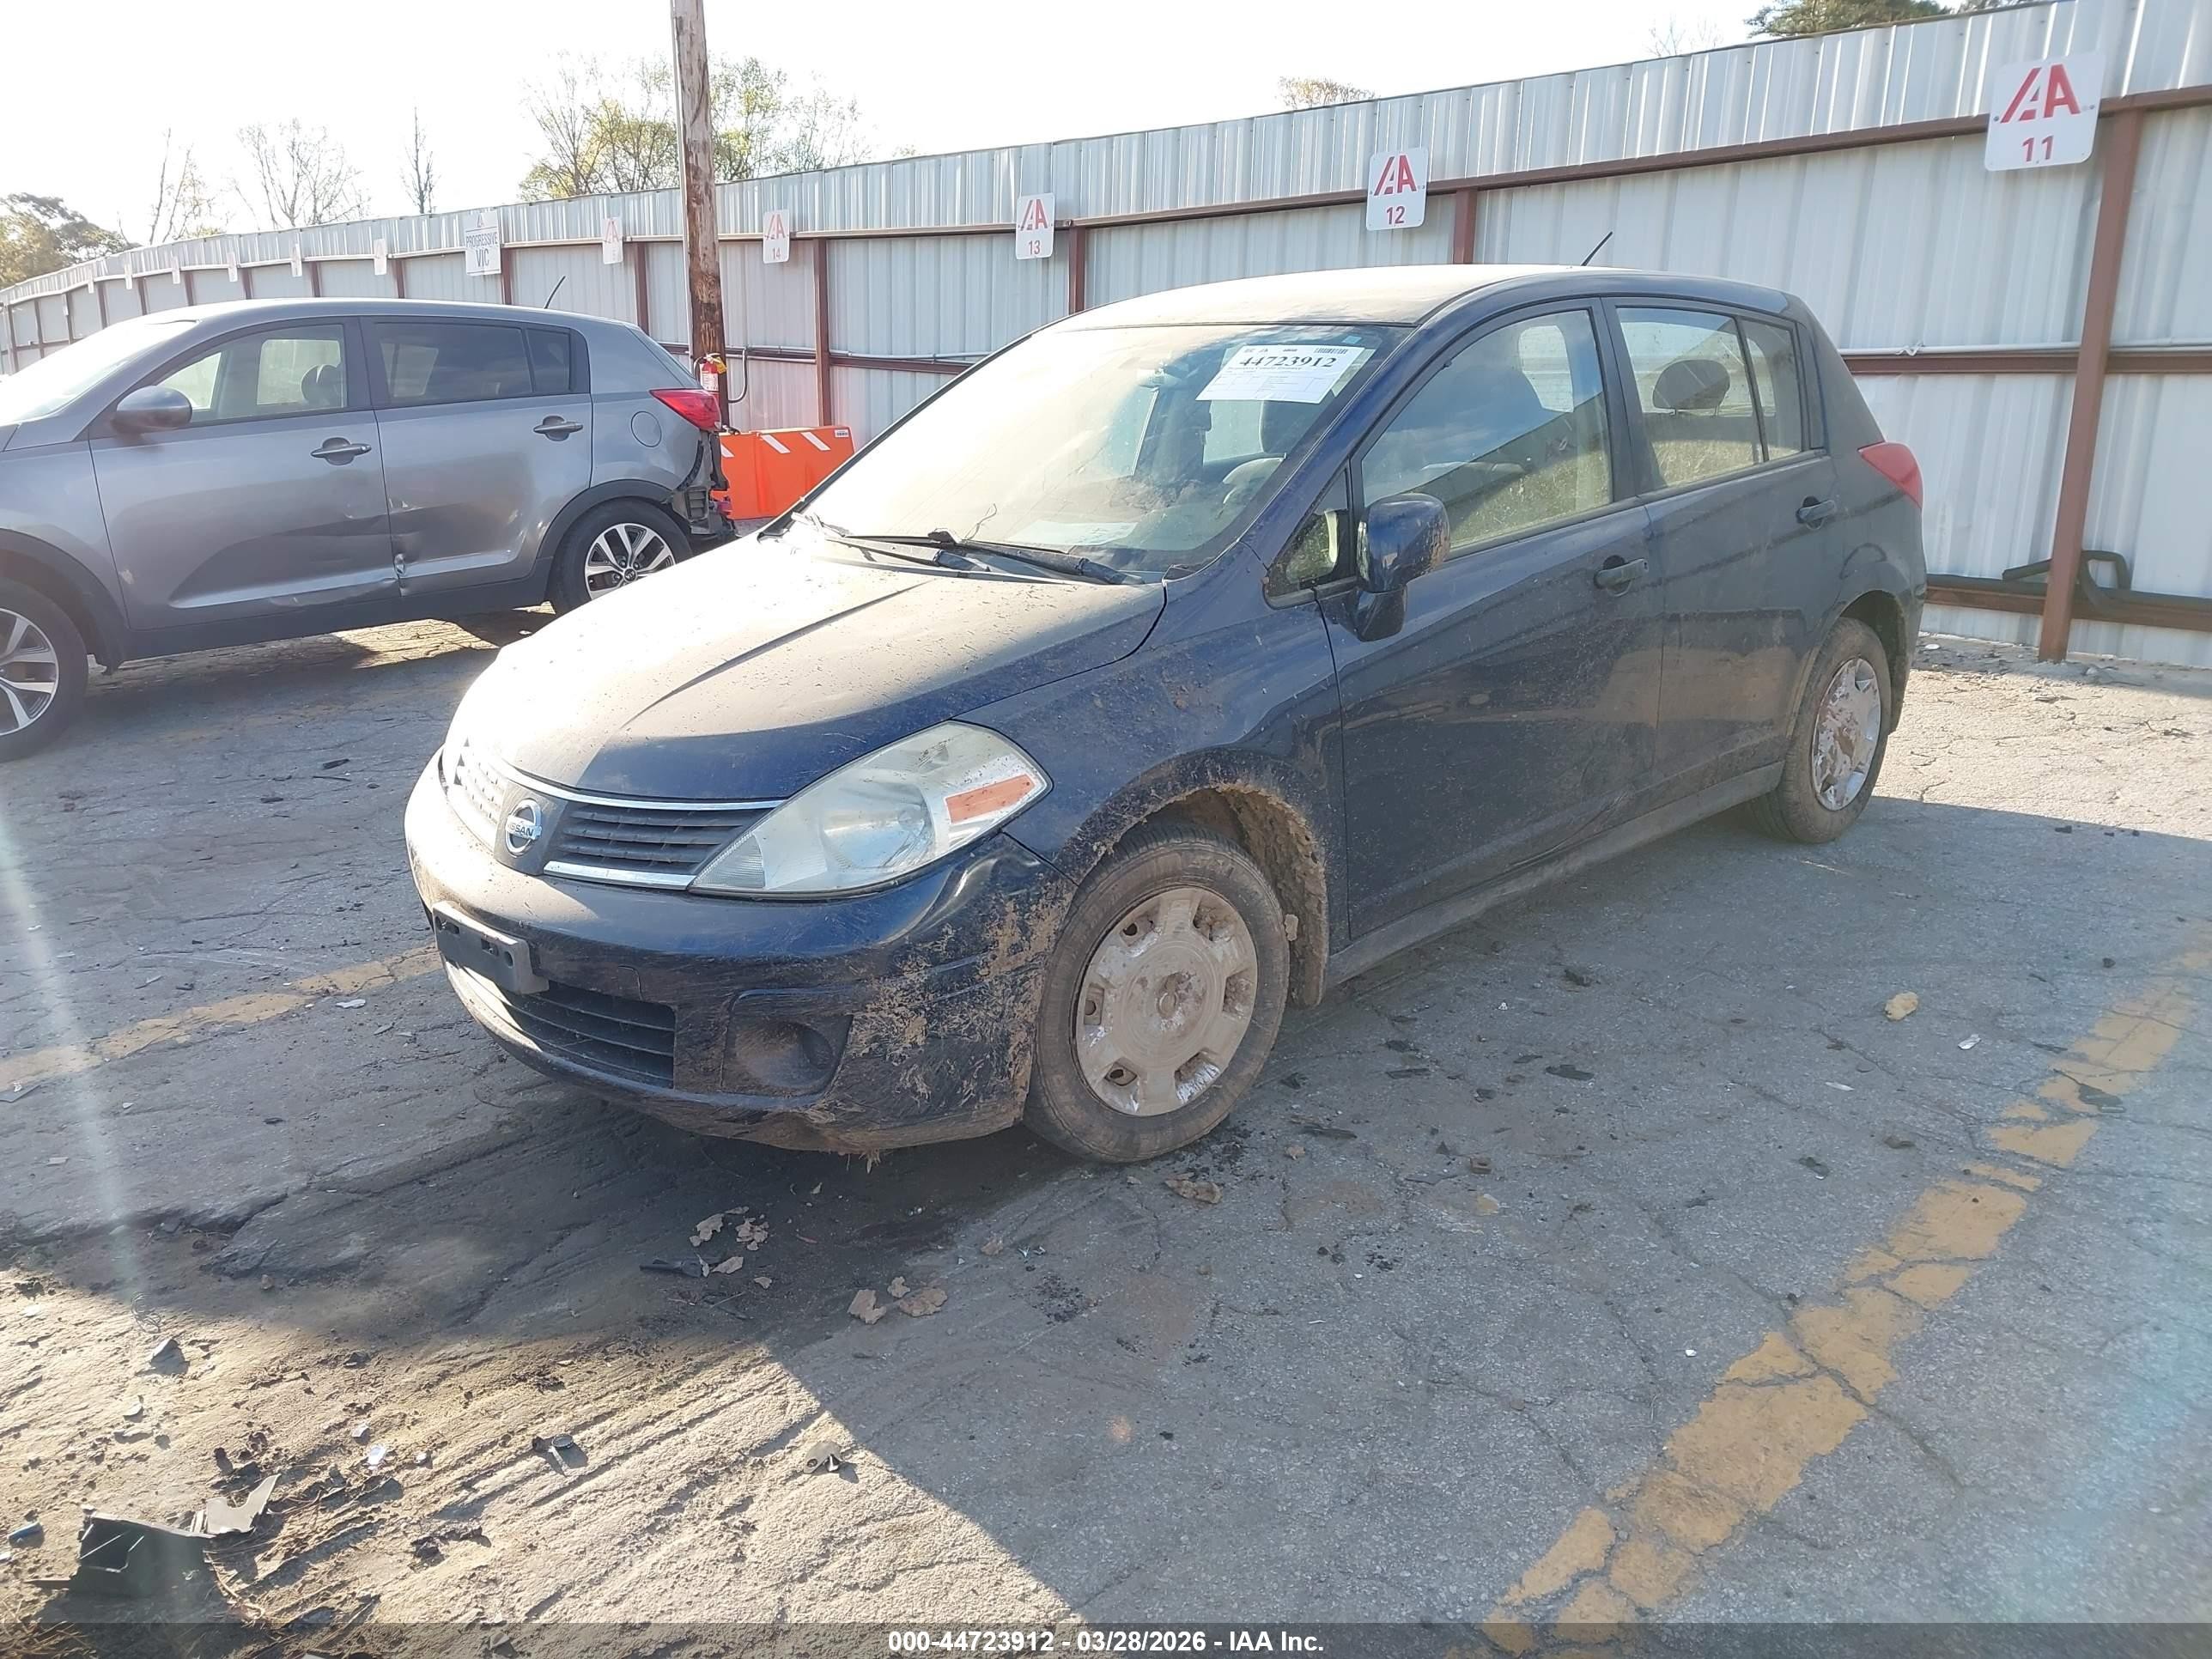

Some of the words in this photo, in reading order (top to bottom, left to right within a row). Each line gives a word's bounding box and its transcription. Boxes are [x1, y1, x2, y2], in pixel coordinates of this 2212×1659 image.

[2022, 135, 2054, 162] 11
[1386, 205, 1406, 225] 12
[772, 246, 781, 260] 14
[1029, 240, 1042, 256] 13
[476, 247, 489, 268] VIC
[1239, 356, 1337, 368] 44723912
